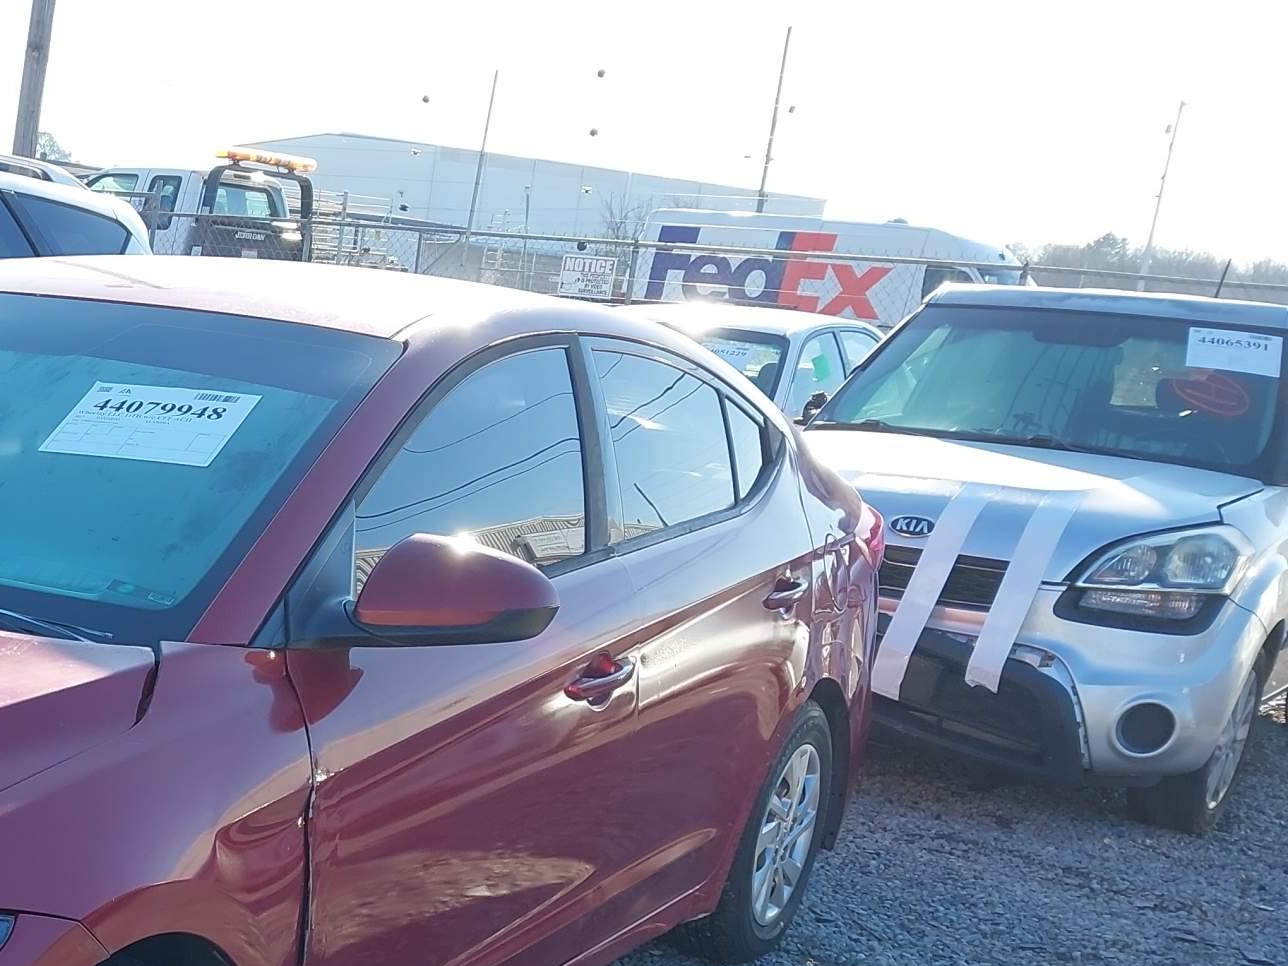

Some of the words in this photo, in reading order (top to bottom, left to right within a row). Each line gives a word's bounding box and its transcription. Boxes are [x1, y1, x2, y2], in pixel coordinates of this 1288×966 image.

[564, 258, 614, 273] NOTICE
[644, 225, 896, 321] FedEx
[1198, 336, 1269, 352] 44065391
[93, 398, 227, 421] 44079948
[896, 518, 929, 533] KIA
